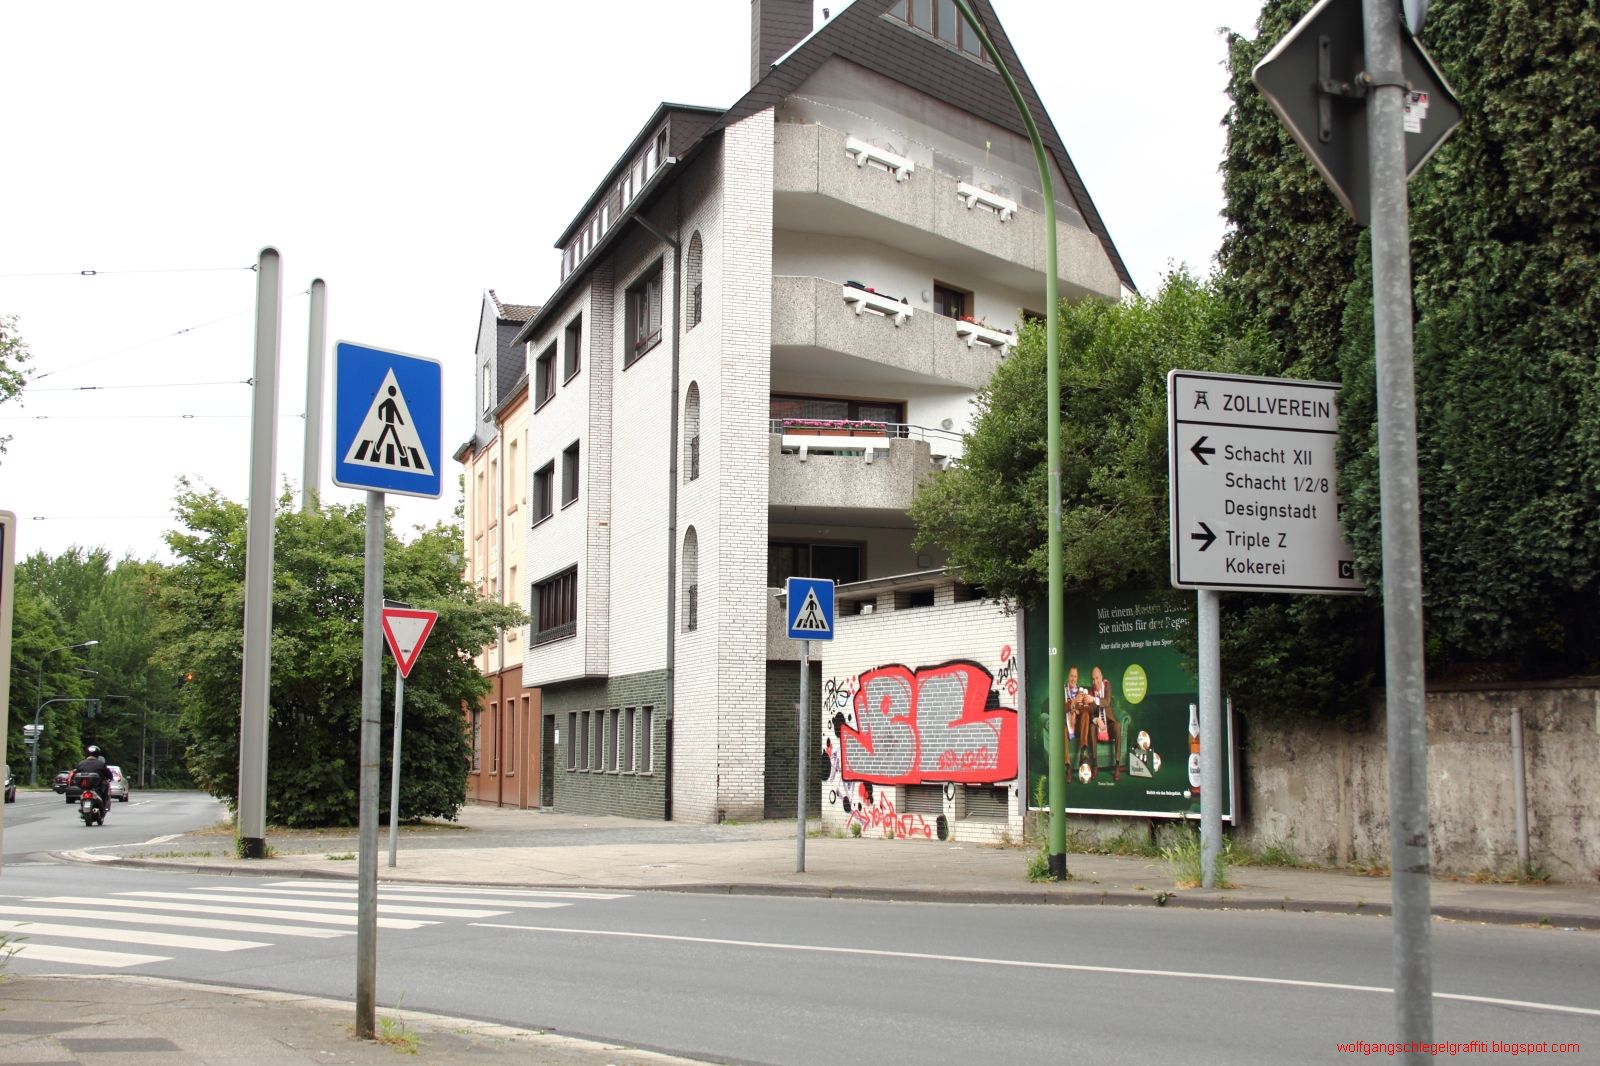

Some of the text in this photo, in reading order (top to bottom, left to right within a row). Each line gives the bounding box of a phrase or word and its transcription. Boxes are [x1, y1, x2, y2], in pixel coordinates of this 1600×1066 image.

[1223, 394, 1330, 418] ZOLLVEREIN
[1224, 445, 1312, 466] Schacht XII
[1225, 472, 1329, 493] Schacht 1/2/8
[1225, 500, 1317, 520] Designstadt
[1225, 530, 1287, 551] Triple Z
[1226, 557, 1285, 575] Kokerei
[1097, 607, 1110, 619] Mit
[1111, 606, 1134, 618] einem
[1098, 622, 1110, 634] Sie
[1111, 620, 1133, 633] nichts
[1135, 619, 1147, 631] für
